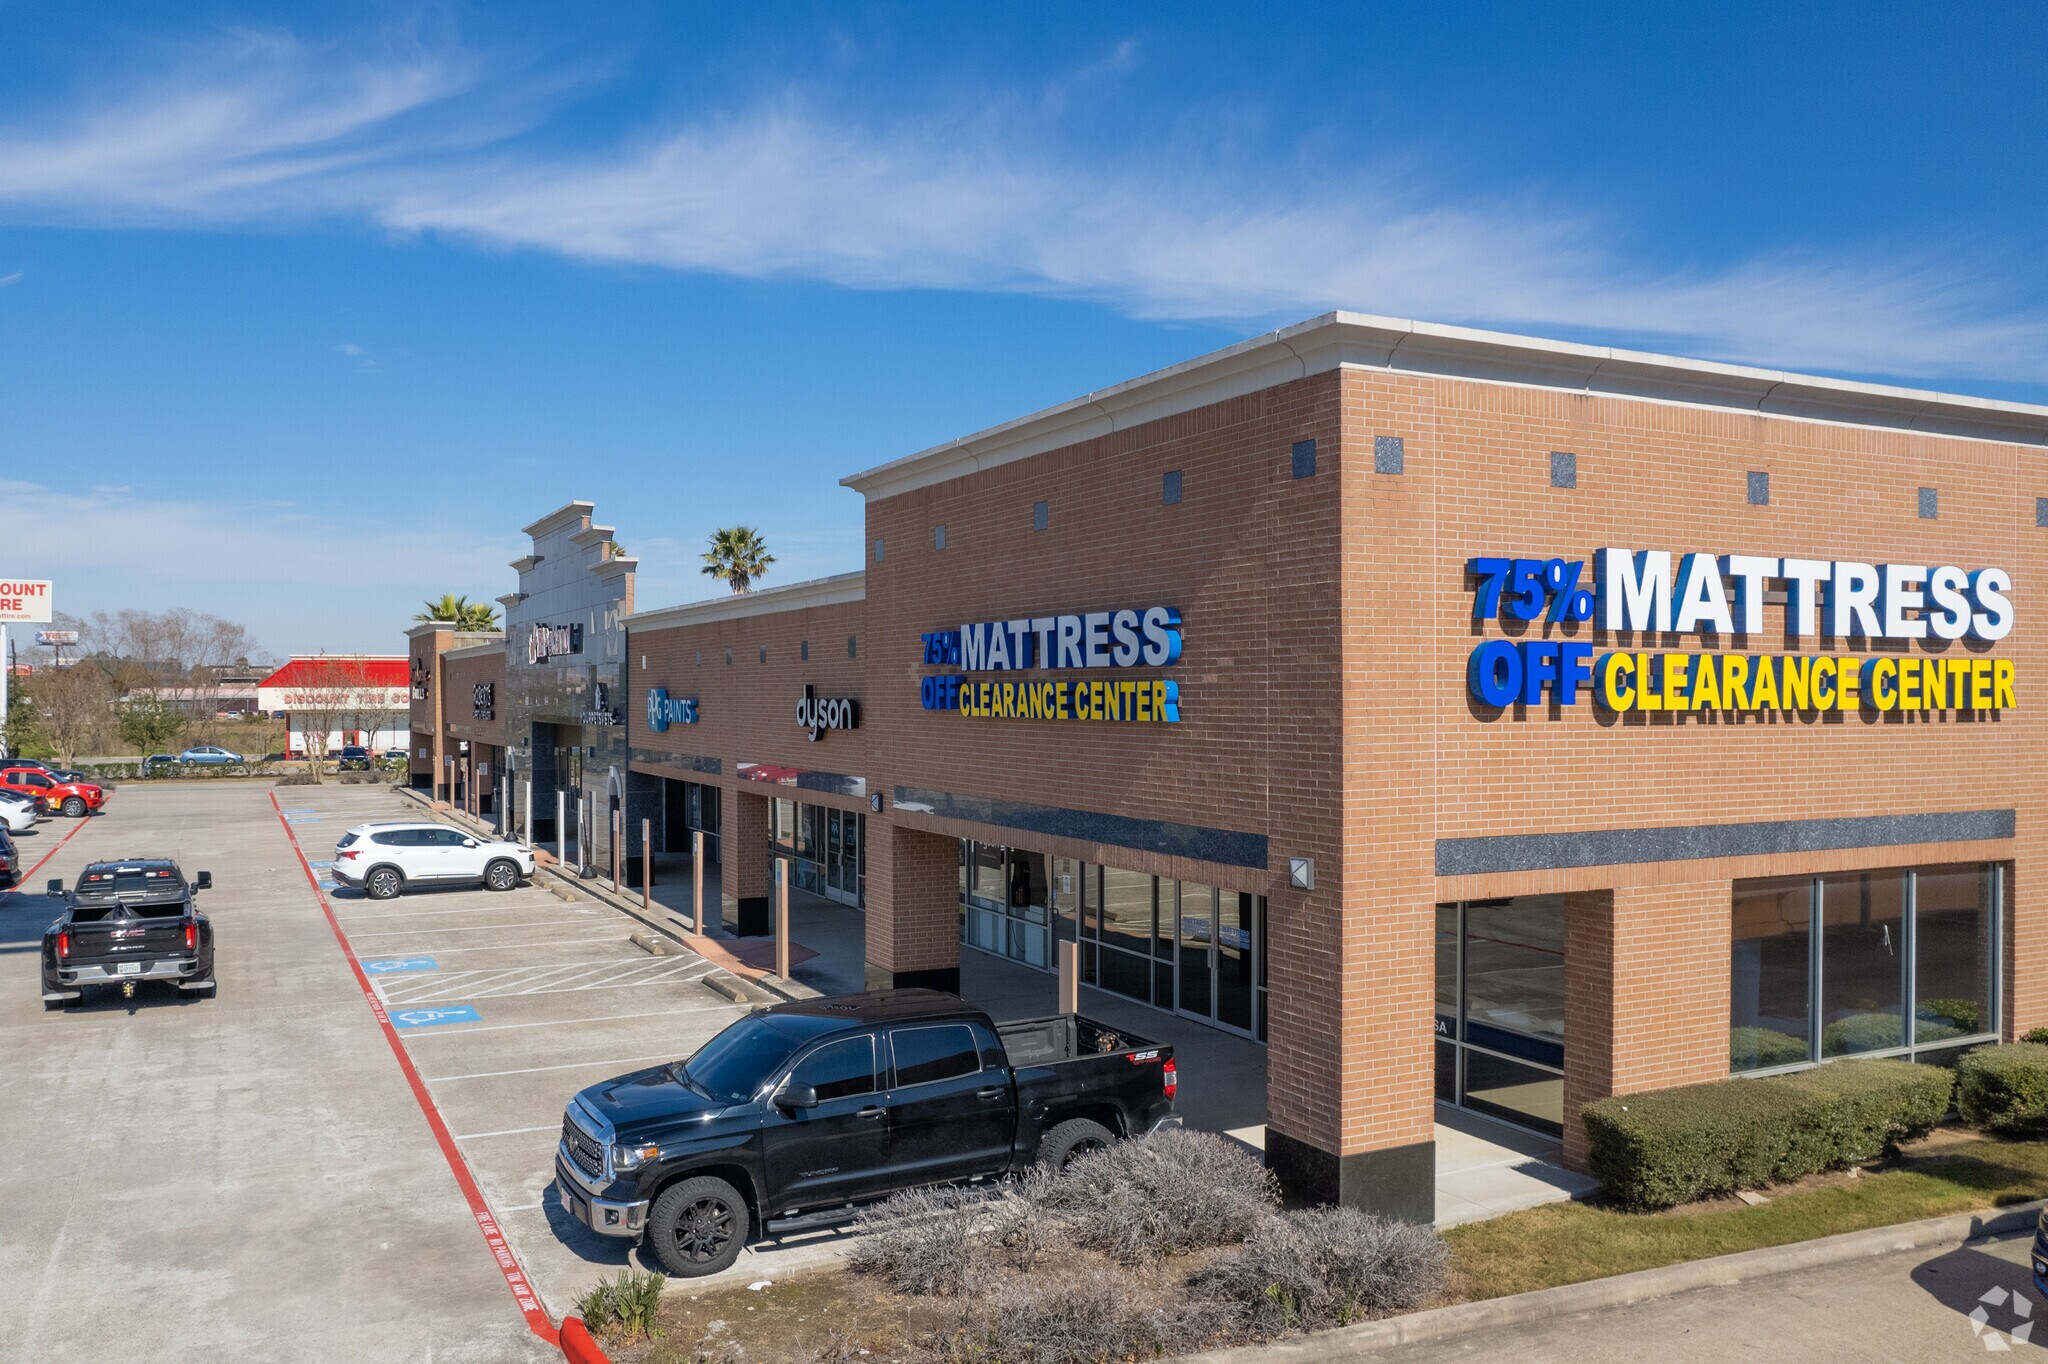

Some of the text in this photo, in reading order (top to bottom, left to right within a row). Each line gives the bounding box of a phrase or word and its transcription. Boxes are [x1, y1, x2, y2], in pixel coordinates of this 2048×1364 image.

[1475, 546, 2015, 641] 75% MATTRESS
[921, 606, 1171, 671] 75% MATTRESS
[1478, 639, 2018, 712] OFF CLEARANCE CENTER
[647, 688, 662, 725] PPG
[664, 699, 692, 724] PAINTS
[920, 675, 1169, 722] OFF CLEARANCE CENTER
[796, 684, 853, 742] dyson
[1125, 1050, 1159, 1062] TSS
[475, 1212, 491, 1223] FIRE
[481, 1223, 498, 1235] LANE
[488, 1237, 504, 1246] NO
[492, 1245, 516, 1268] PARKING
[505, 1271, 524, 1283] TOW
[518, 1296, 540, 1312] ZONE
